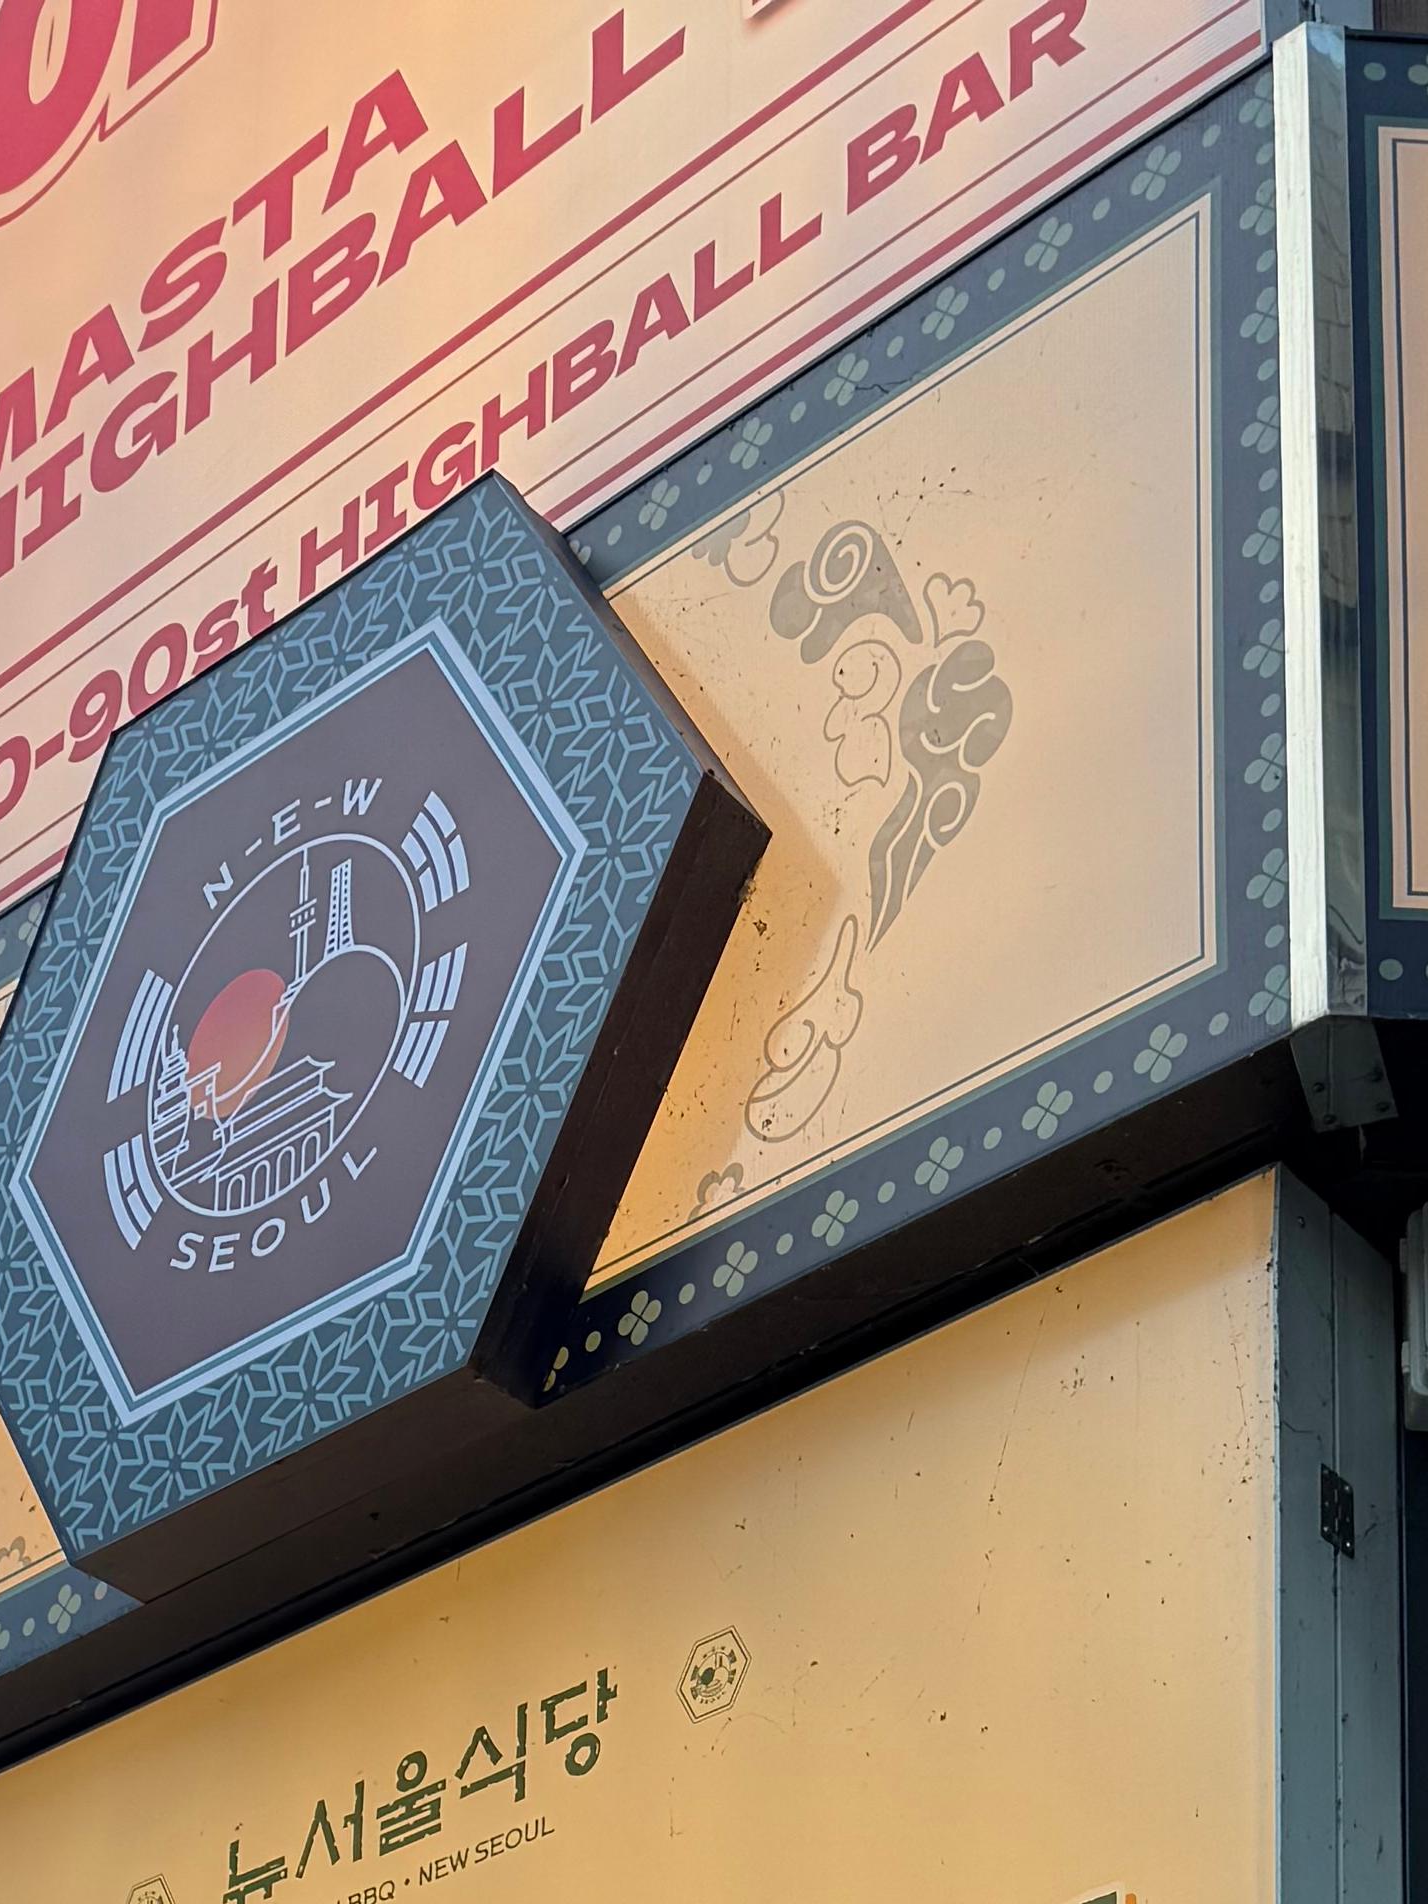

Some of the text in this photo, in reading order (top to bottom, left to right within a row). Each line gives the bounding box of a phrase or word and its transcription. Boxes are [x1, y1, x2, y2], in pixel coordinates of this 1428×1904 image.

[298, 193, 822, 603] HIGHBALL
[844, 0, 1088, 186] BAR
[202, 777, 382, 910] N-E-W
[170, 1147, 377, 1273] SEOUL
[418, 1848, 470, 1888] NEW
[474, 1816, 555, 1865] SEOUL
